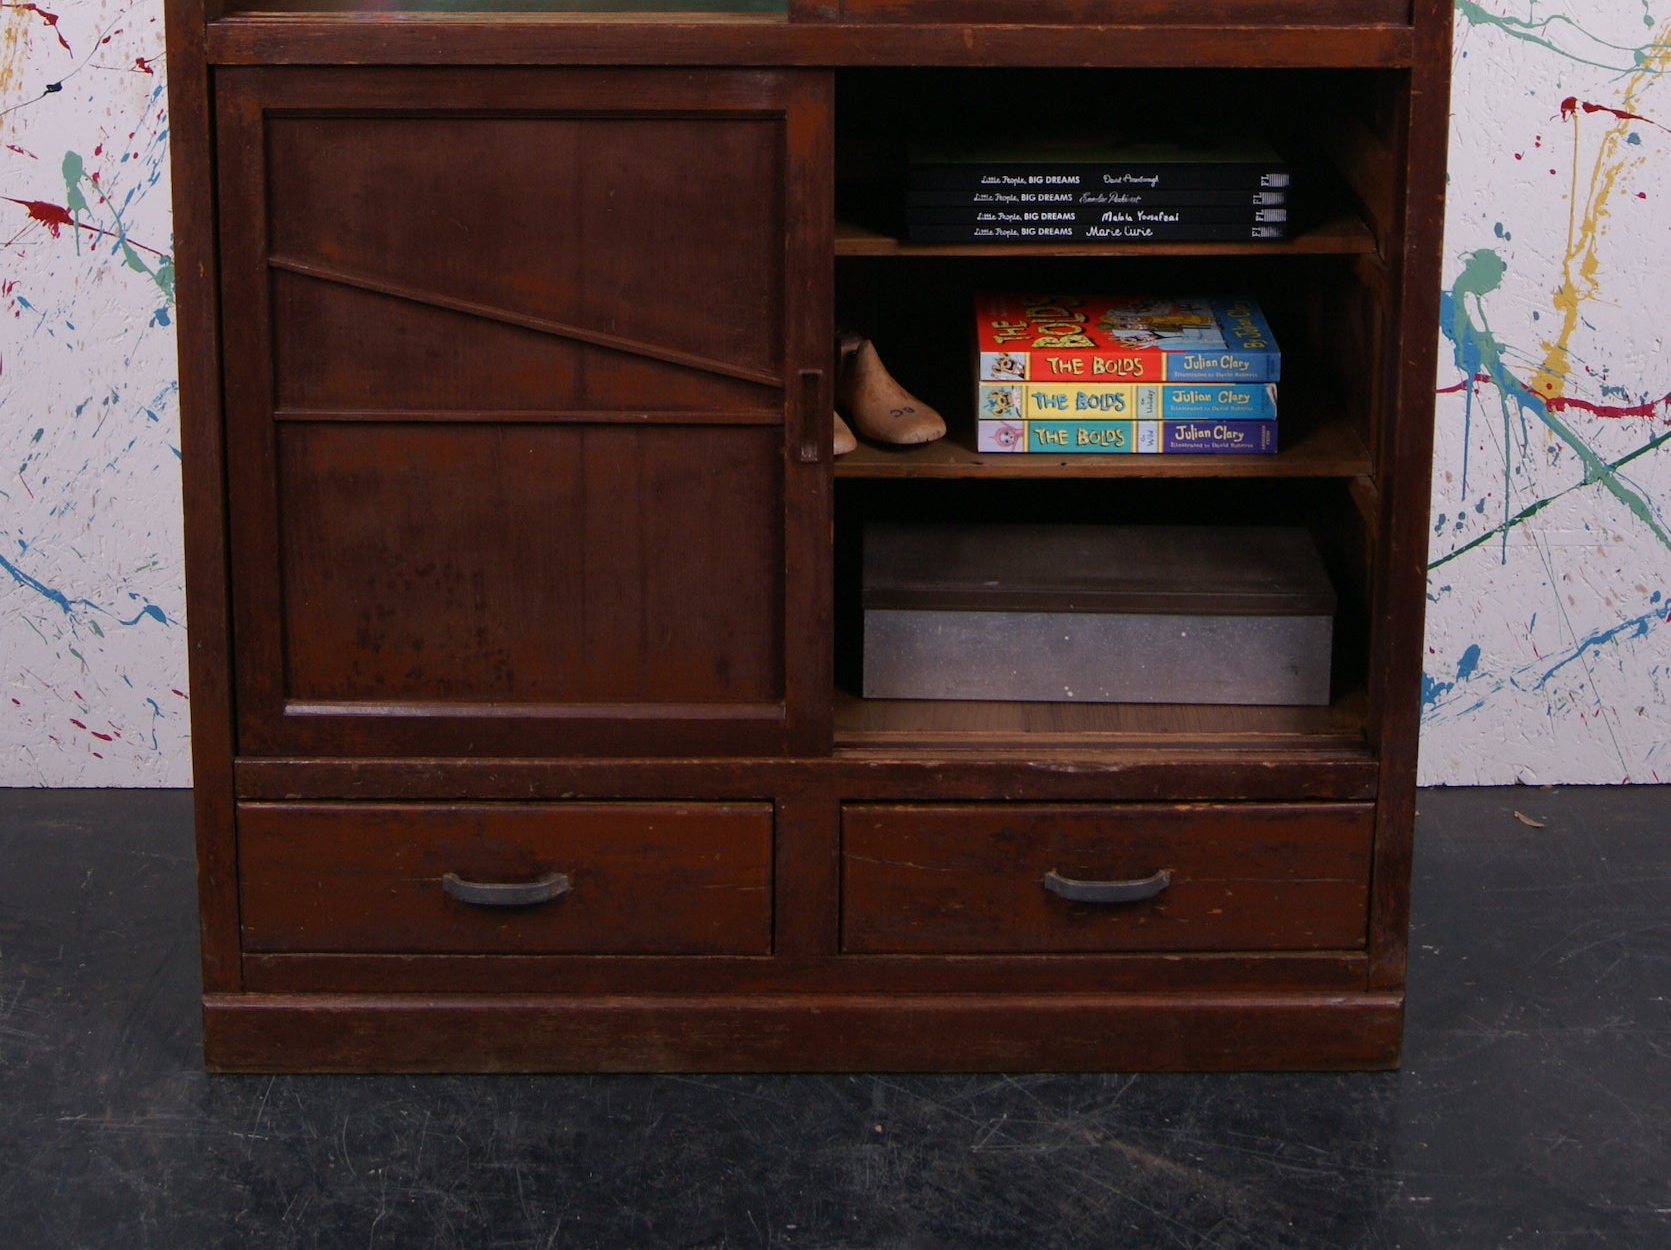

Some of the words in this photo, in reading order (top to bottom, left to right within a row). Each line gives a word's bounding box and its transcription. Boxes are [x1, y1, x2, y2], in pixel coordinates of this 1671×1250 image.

[981, 176, 1001, 184] Little
[1028, 176, 1043, 184] BIG
[1046, 176, 1080, 184] DREAMS
[973, 193, 994, 201] Little
[1021, 193, 1036, 201] BIG
[1038, 193, 1073, 201] DREAMS
[977, 212, 997, 220] Little
[1024, 212, 1039, 220] BIG
[1041, 212, 1076, 220] DREAMS
[1102, 211, 1133, 222] Malala
[1137, 210, 1179, 222] Yousafzai
[974, 228, 994, 236] Little
[1021, 228, 1036, 236] BIG
[1038, 228, 1073, 236] DREAMS
[1086, 226, 1122, 237] Marie
[1124, 225, 1153, 237] Curie
[992, 319, 1033, 344] THE
[1046, 356, 1085, 375] THE
[1092, 356, 1144, 377] BOLDS
[1183, 354, 1218, 370] Julian
[1220, 354, 1250, 371] Clary
[1031, 391, 1069, 411] THE
[1076, 391, 1126, 412] BOLDS
[1172, 390, 1212, 404] Julian
[1218, 390, 1251, 404] Clary
[1034, 427, 1070, 446] THE
[1077, 427, 1125, 448] BOLDS
[1175, 424, 1211, 441] Julian
[1213, 425, 1244, 442] Clary
